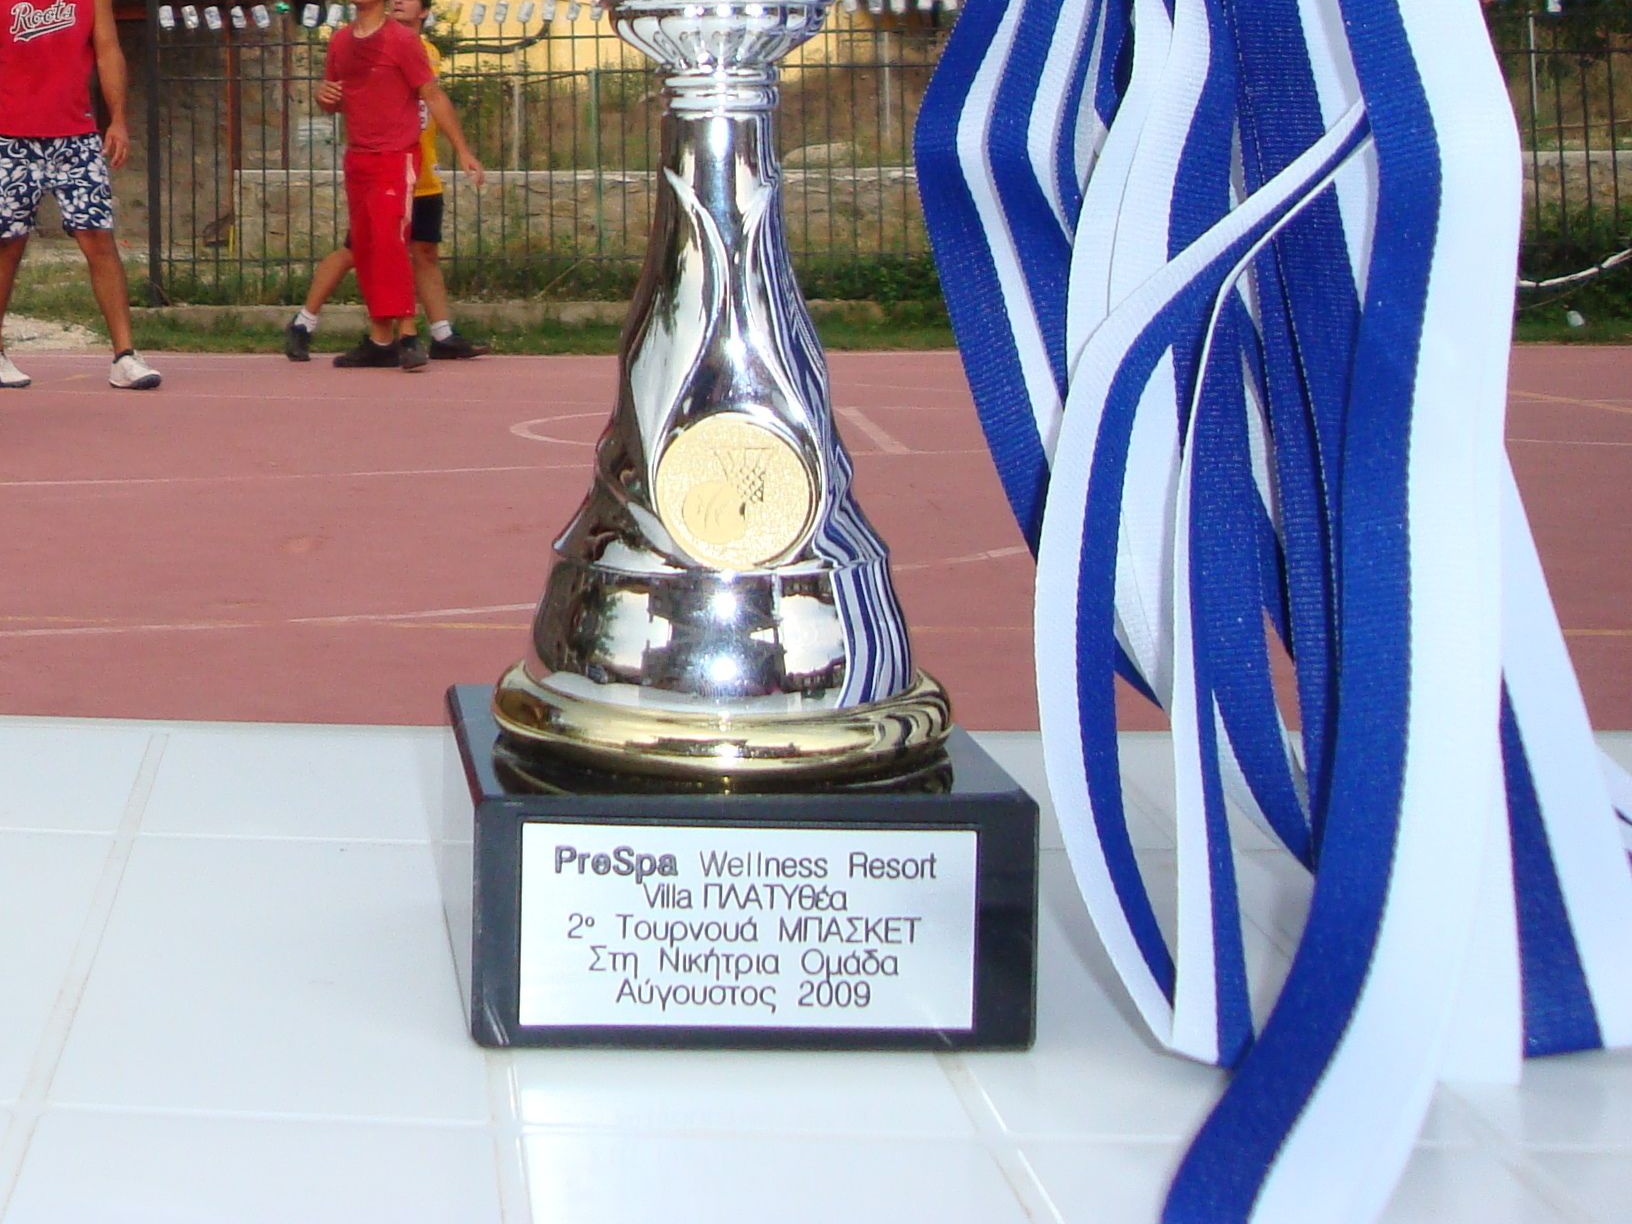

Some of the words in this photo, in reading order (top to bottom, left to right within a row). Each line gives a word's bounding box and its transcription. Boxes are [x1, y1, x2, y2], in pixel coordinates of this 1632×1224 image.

[554, 845, 679, 885] PreSpa
[699, 850, 828, 879] Wellness
[849, 851, 938, 880] Resort
[643, 883, 693, 909] Villa
[616, 914, 759, 947] Τουρνουά
[779, 916, 922, 945] ΜΠΑΣΚΕΤ
[588, 945, 639, 979] Στη
[659, 947, 780, 982] Νικήτρια
[801, 948, 900, 982] Ομάδα
[615, 978, 777, 1013] Αύγουστος
[798, 980, 871, 1008] 2009
